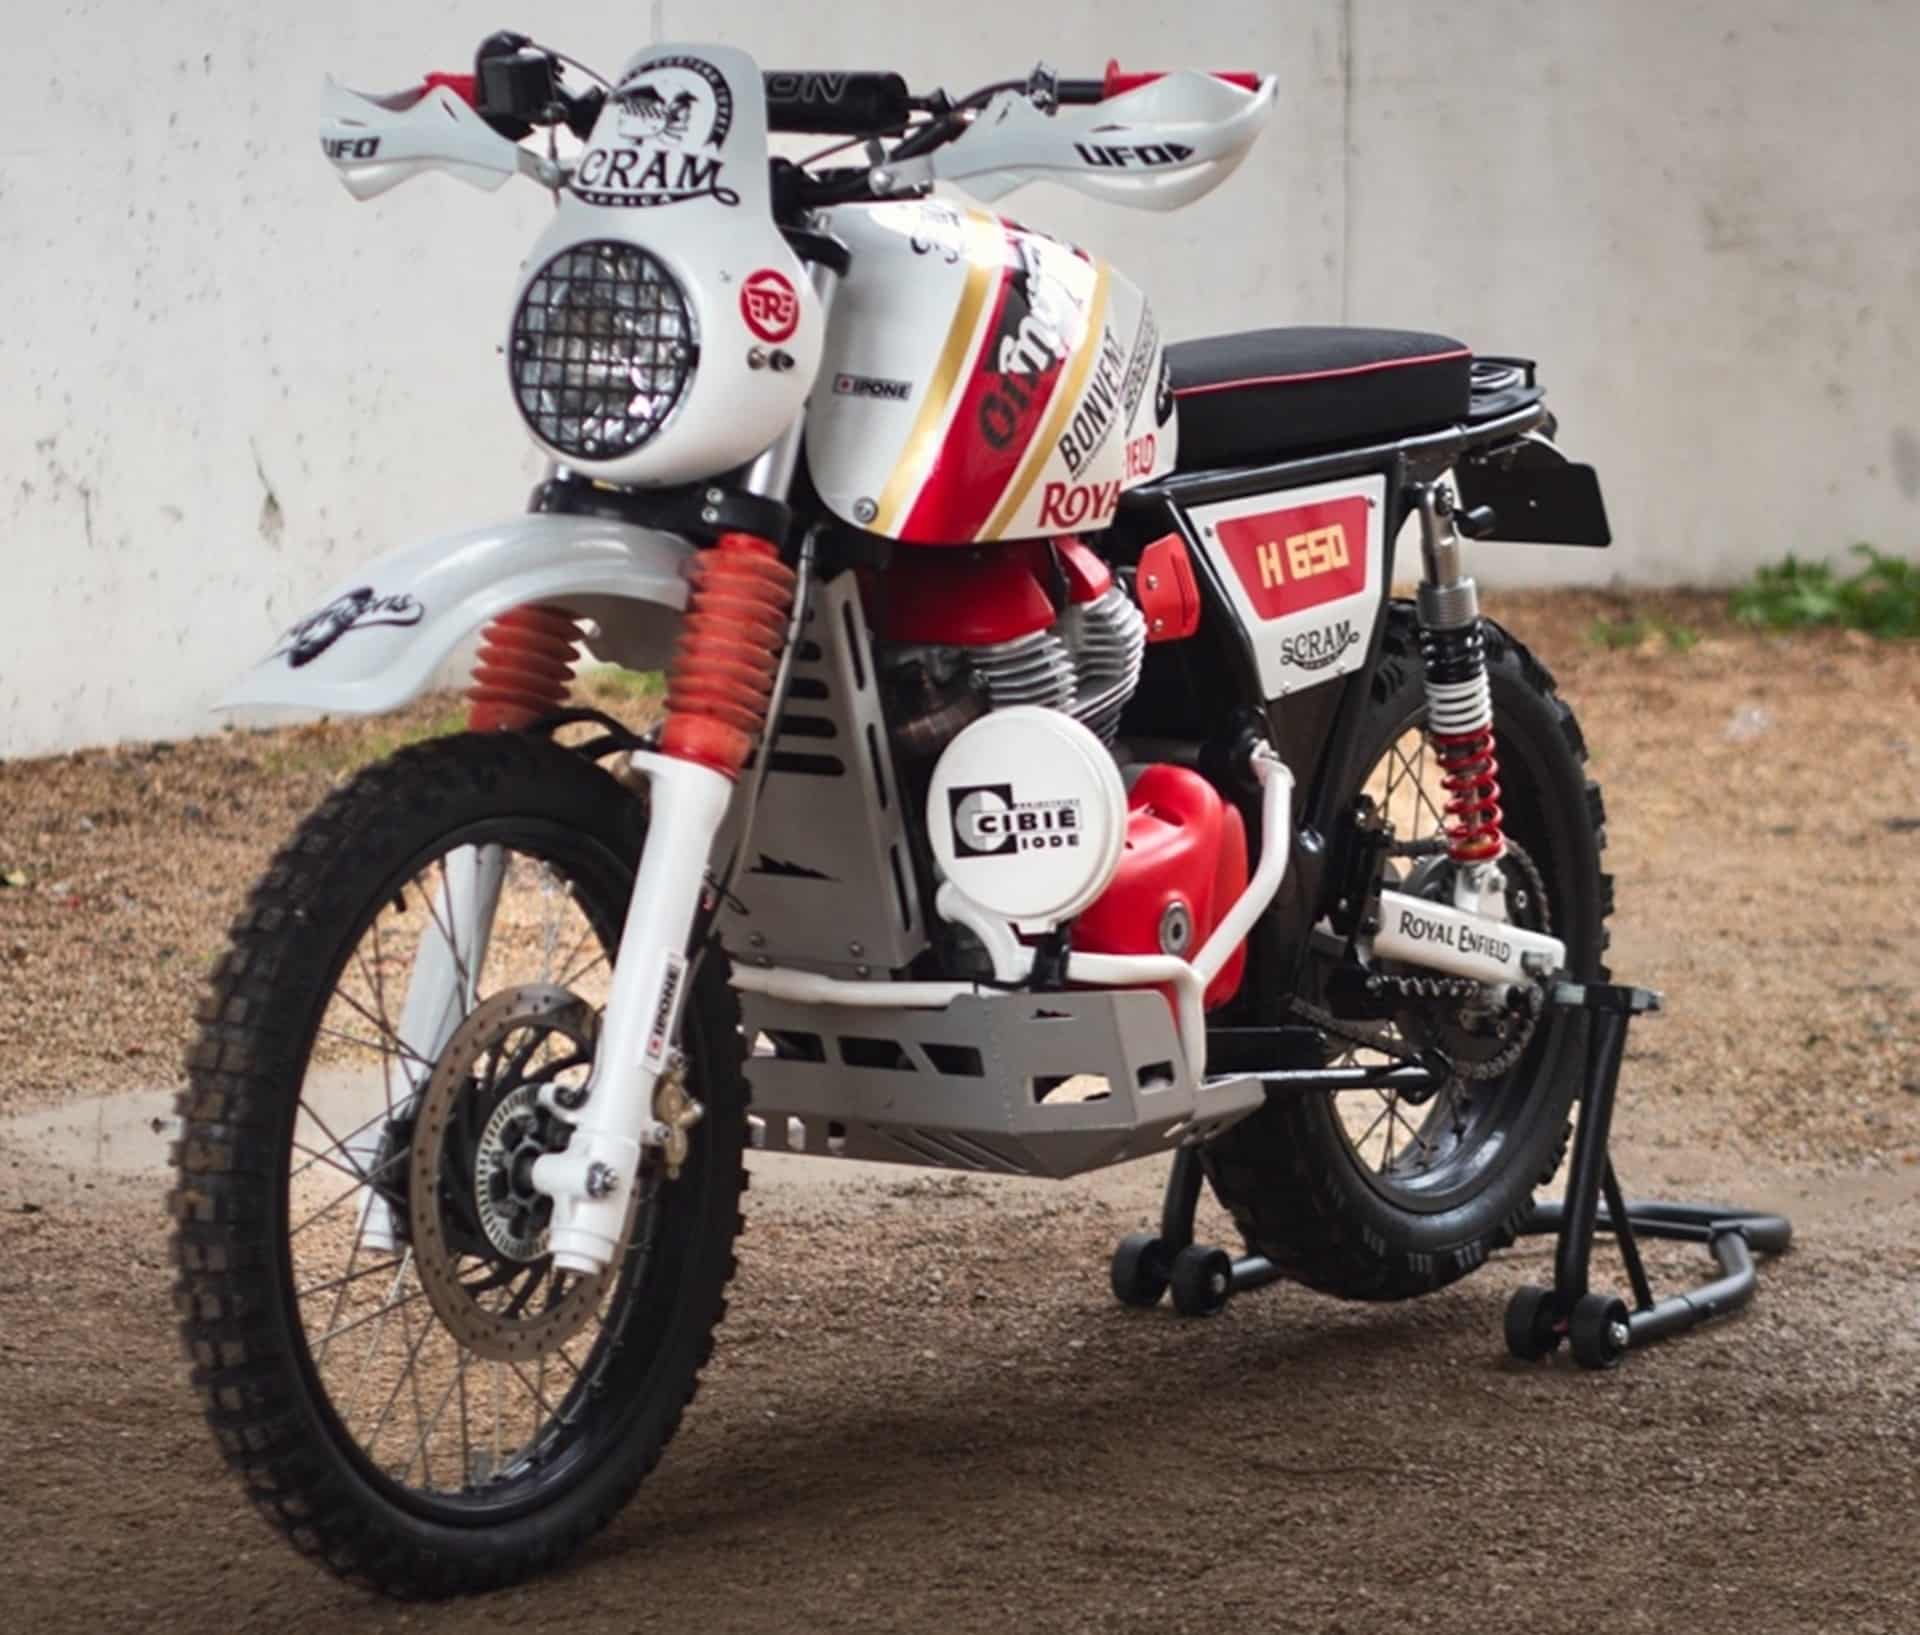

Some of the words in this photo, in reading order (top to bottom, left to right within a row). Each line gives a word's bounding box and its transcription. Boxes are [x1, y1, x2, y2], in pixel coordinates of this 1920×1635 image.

[1072, 141, 1175, 167] UFO
[853, 379, 911, 400] IPONE
[1256, 541, 1284, 589] H
[1285, 523, 1350, 580] 650
[1281, 619, 1350, 658] SCRAM
[1021, 834, 1079, 850] IODE
[1400, 911, 1454, 947] ROYAL
[1458, 925, 1512, 965] ENFIELD
